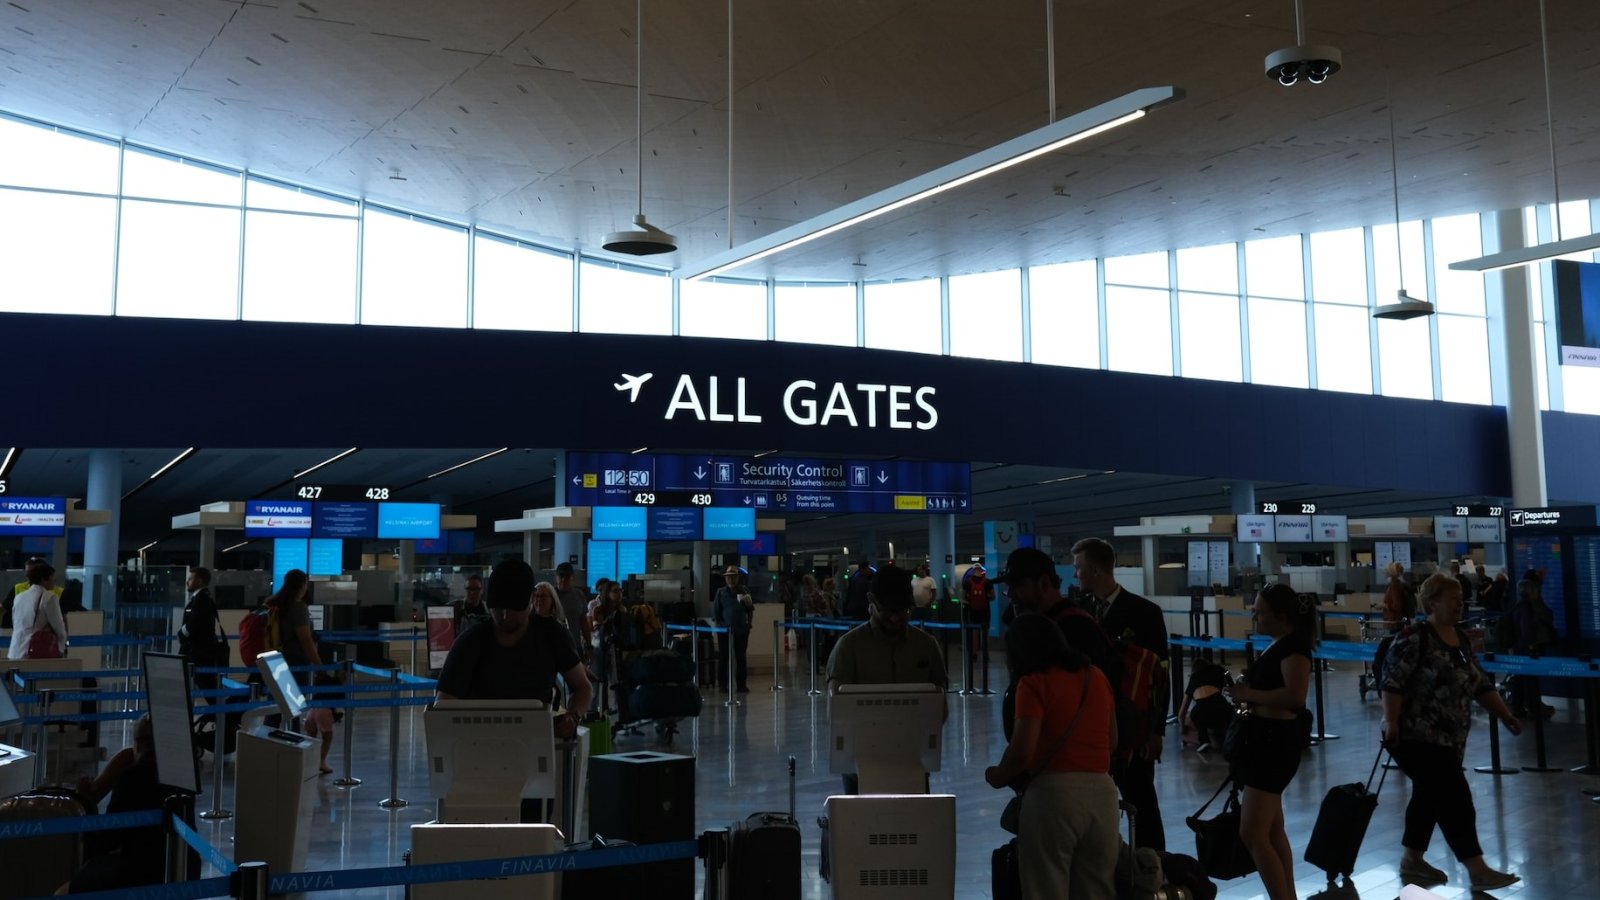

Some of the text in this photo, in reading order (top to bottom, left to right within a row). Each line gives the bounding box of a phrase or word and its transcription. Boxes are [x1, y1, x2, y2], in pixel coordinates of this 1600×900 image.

[664, 374, 938, 430] ALL GATES
[743, 463, 842, 479] Security Control
[605, 470, 649, 486] 12:50
[739, 477, 846, 487] Turvatarkastus Säkerhetskontroll
[298, 486, 389, 500] 427 428
[635, 493, 712, 505] 429 430
[8, 502, 55, 511] RYANAIR
[1263, 503, 1315, 513] 230 229
[1456, 506, 1502, 516] 228 227
[1525, 511, 1560, 520] Departures
[499, 855, 577, 874] FINAVIA
